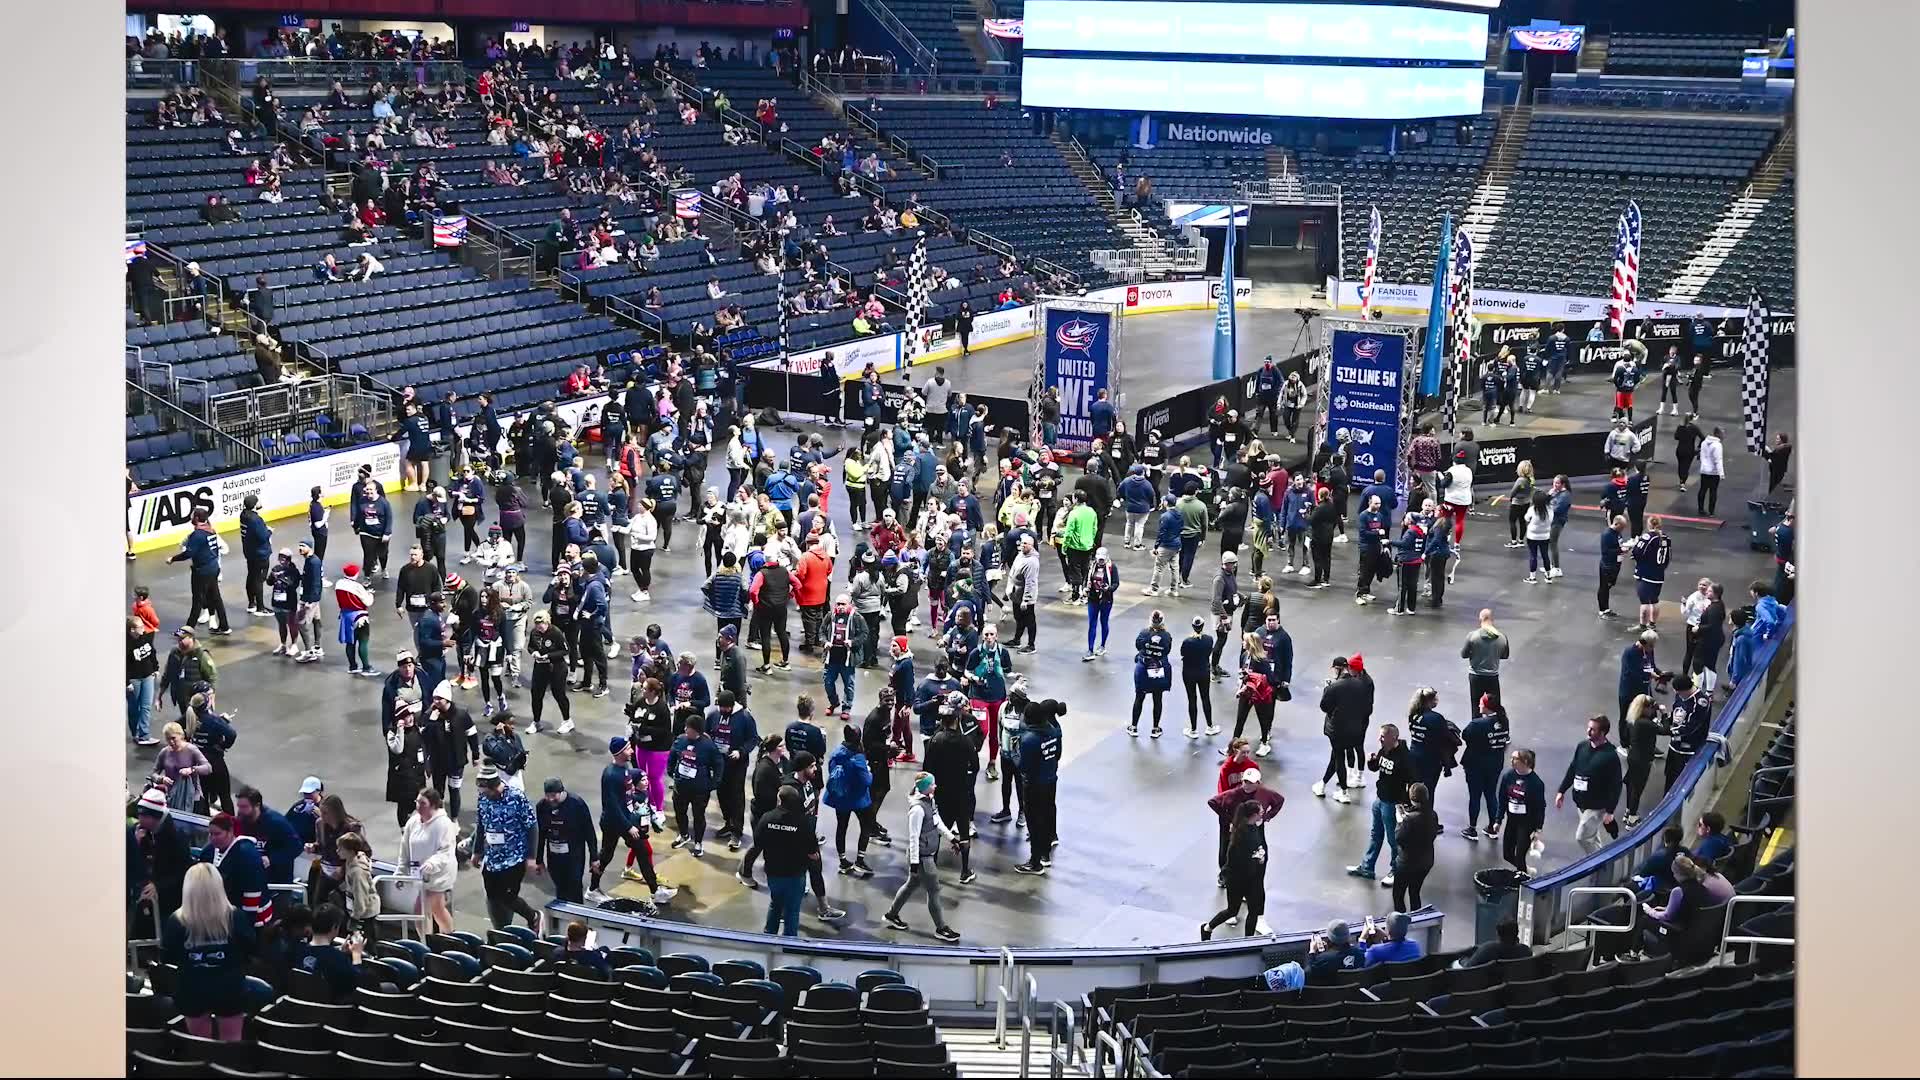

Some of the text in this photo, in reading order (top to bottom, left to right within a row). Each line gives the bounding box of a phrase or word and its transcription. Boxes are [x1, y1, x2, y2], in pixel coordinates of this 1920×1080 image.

[282, 14, 299, 24] 115
[778, 28, 792, 38] 117
[1168, 123, 1272, 144] Nationwide
[1141, 290, 1172, 300] TOYOTA
[1236, 288, 1250, 297] PP
[1378, 287, 1418, 296] FANDUEL
[1472, 297, 1526, 309] ationwide
[980, 318, 1011, 334] OhioHealth
[796, 356, 822, 374] Wyler
[1058, 358, 1096, 378] UNITED
[1336, 366, 1397, 388] 5TH LINE 5K
[1058, 376, 1095, 418] WE
[1350, 400, 1396, 412] OhioHealth
[1057, 418, 1093, 438] STAND
[1484, 447, 1518, 456] Nationwide
[222, 472, 266, 490] Advanced
[154, 486, 214, 530] ADS
[768, 822, 798, 832] RACE CREW
